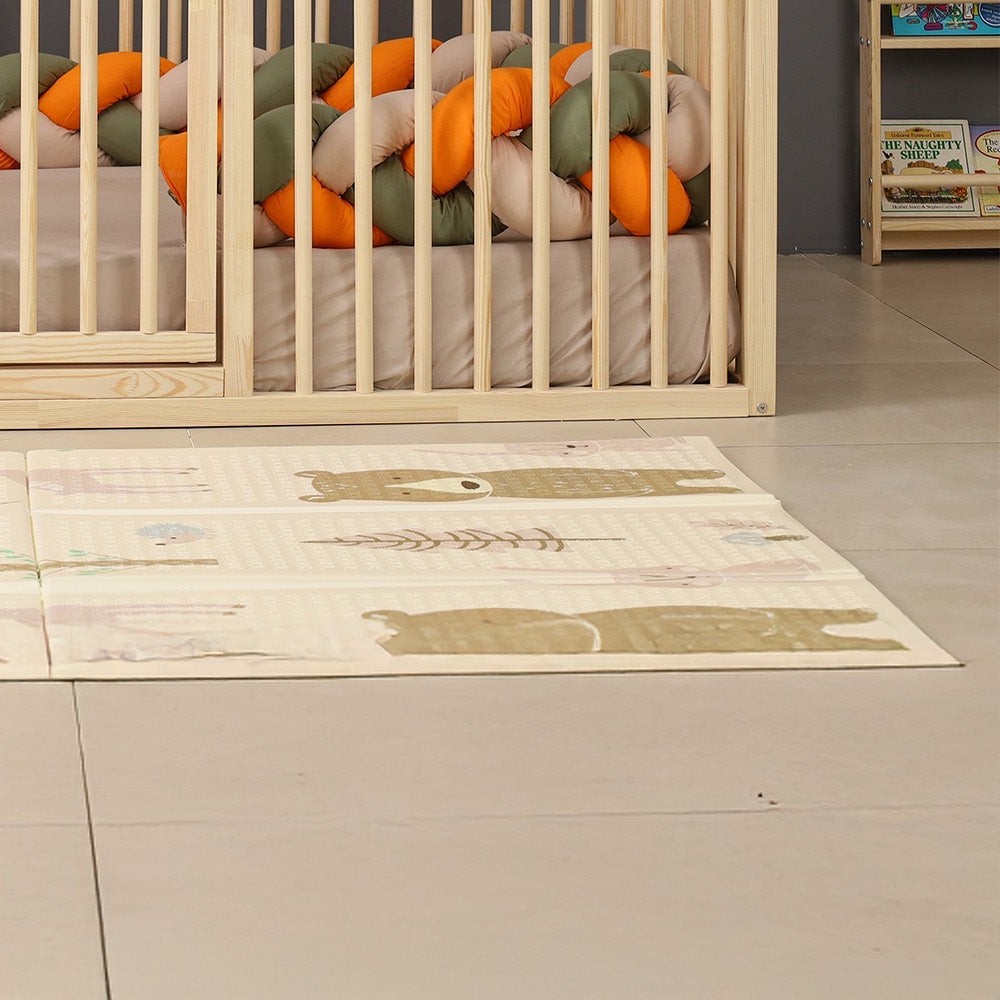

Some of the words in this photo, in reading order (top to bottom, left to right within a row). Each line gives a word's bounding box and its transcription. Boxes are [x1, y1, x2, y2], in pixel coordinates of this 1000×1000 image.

[904, 140, 962, 150] NAUGHTY
[983, 138, 998, 146] The
[900, 150, 941, 160] SHEEP
